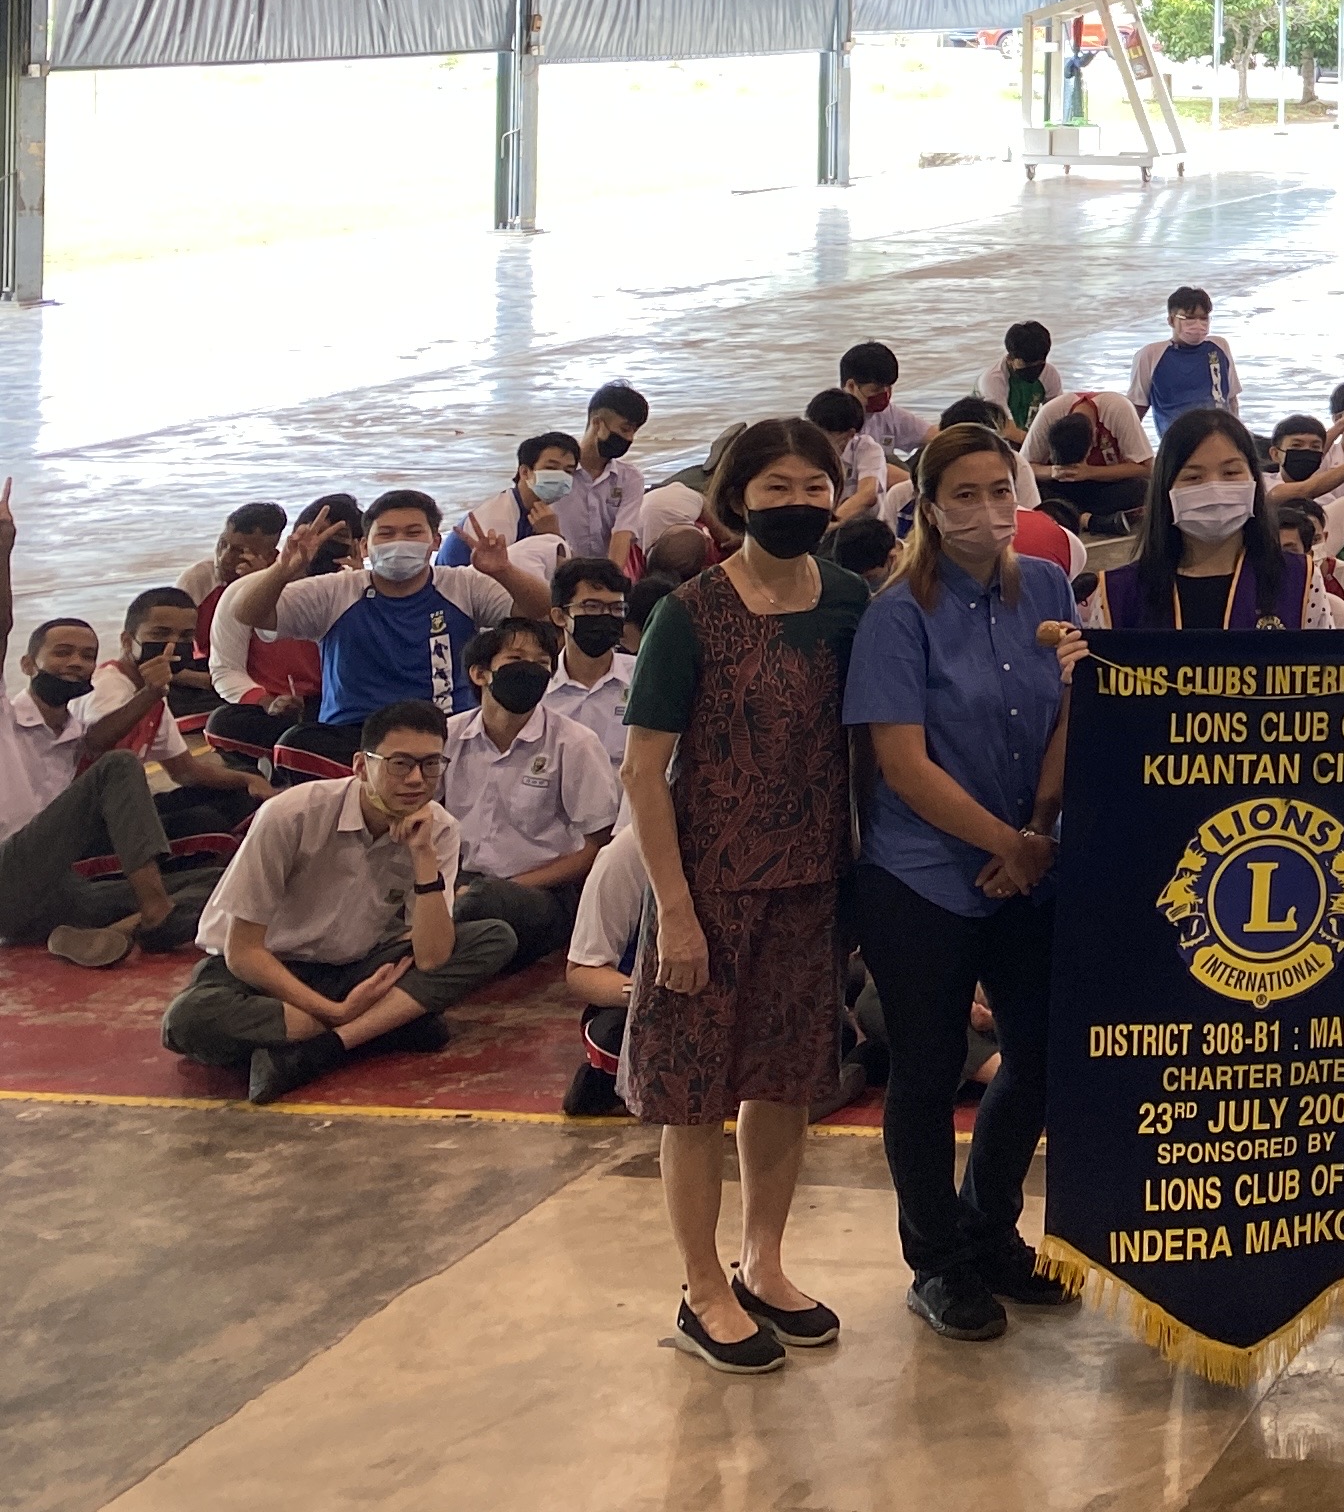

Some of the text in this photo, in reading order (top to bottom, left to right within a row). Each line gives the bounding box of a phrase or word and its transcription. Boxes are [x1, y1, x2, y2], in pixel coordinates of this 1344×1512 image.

[1098, 666, 1168, 696] LIONS
[1177, 666, 1257, 695] CLUBS
[1170, 712, 1248, 743] LIONS
[1261, 711, 1330, 742] CLUB
[1143, 753, 1300, 785] KUANTAN
[1207, 803, 1337, 848] LIONS
[1243, 862, 1298, 932] L
[1200, 953, 1326, 992] INTERNATIONAL
[1090, 1024, 1192, 1058] DISTRICT
[1202, 1021, 1281, 1054] 308-B1
[1163, 1063, 1282, 1091] CHARTER
[1138, 1102, 1198, 1134] 23RD
[1208, 1098, 1288, 1133] JULY
[1157, 1131, 1336, 1165] SPONSORED BY
[1145, 1164, 1344, 1212] LIONS CLUB OF
[1110, 1226, 1233, 1264] INDERA
